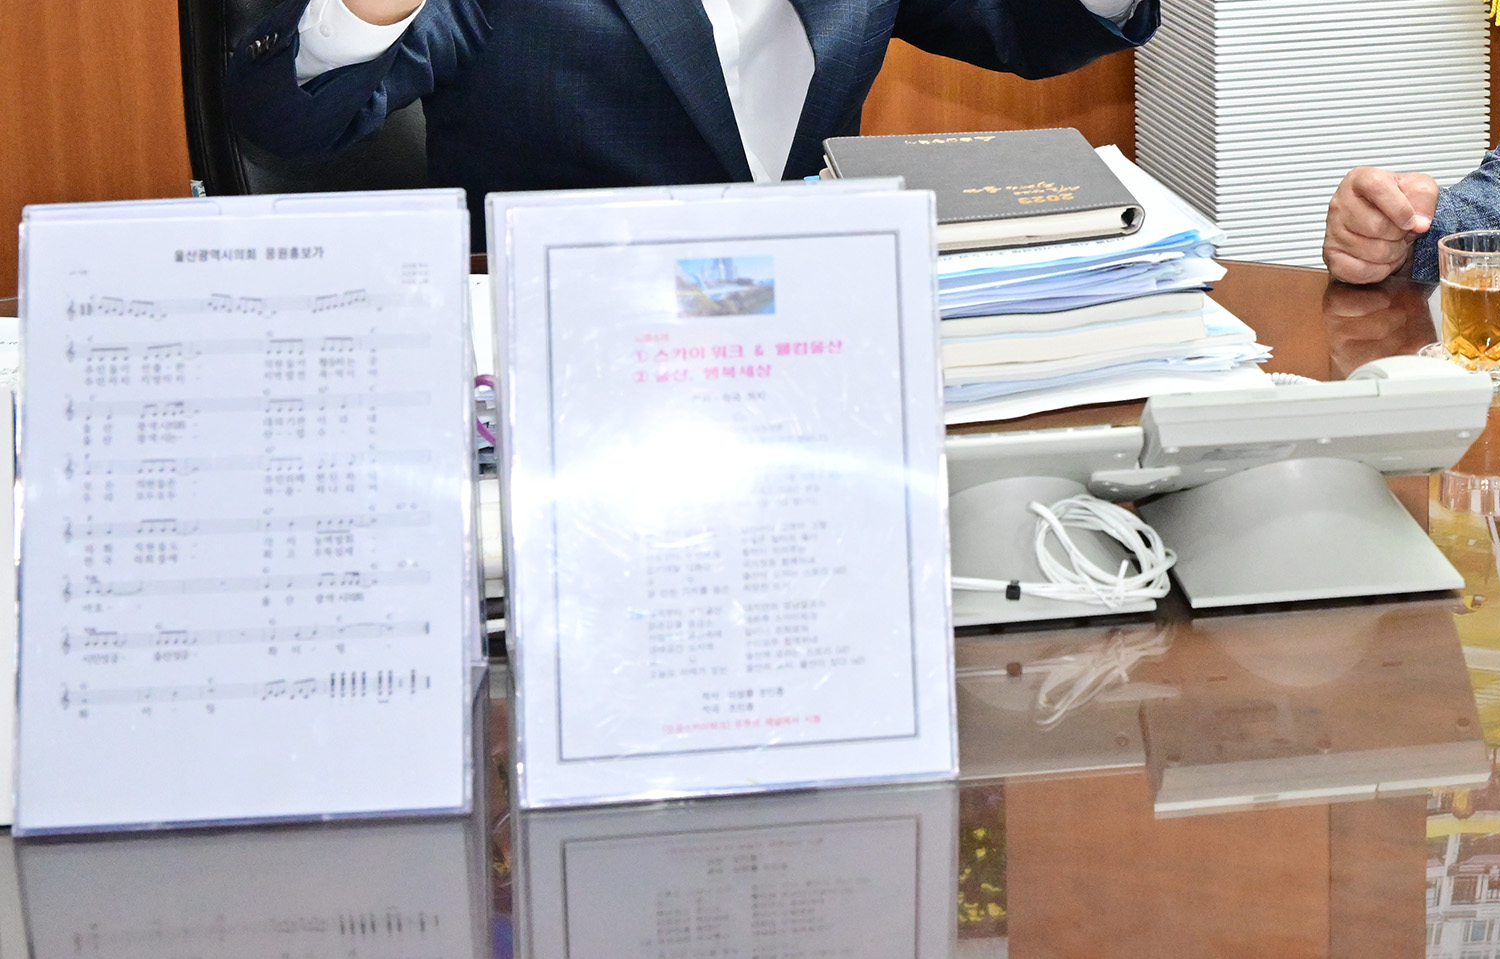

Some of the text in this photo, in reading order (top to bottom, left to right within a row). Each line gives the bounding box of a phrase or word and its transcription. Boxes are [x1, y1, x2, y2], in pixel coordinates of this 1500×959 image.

[1017, 192, 1075, 205] 2023
[174, 248, 257, 263] 울산광역시의회
[653, 346, 705, 362] 스카이
[711, 343, 744, 360] 워크
[754, 343, 765, 357] &
[775, 339, 843, 356] 웰컴울산
[703, 364, 772, 380] 행복세상
